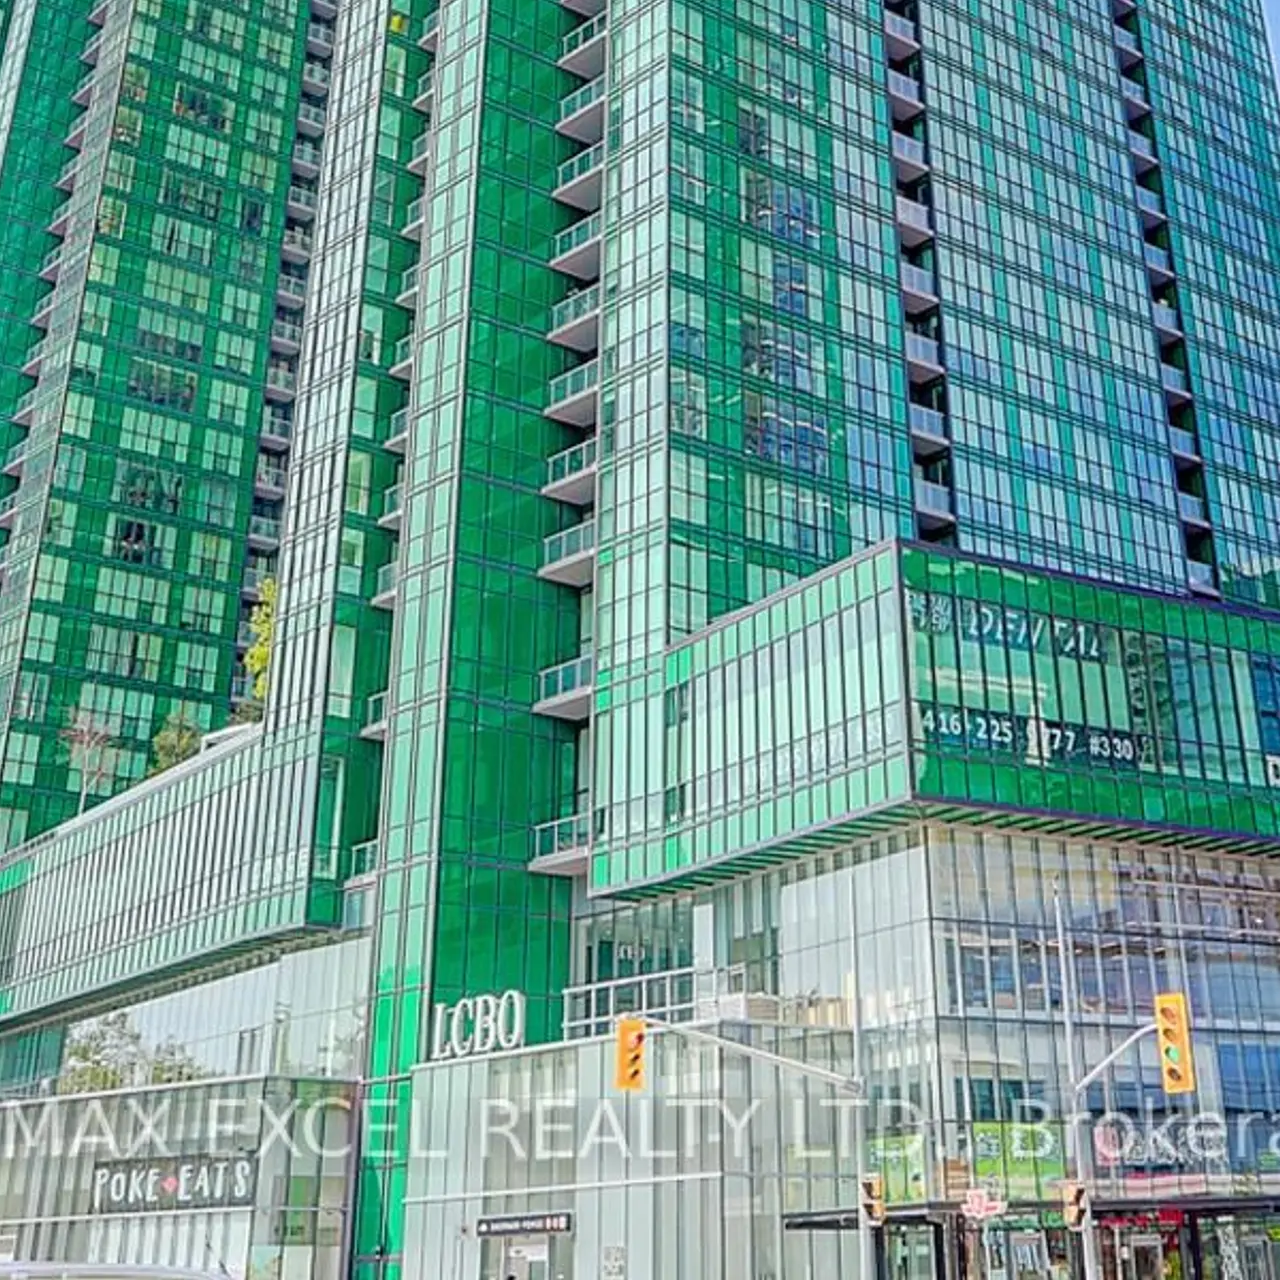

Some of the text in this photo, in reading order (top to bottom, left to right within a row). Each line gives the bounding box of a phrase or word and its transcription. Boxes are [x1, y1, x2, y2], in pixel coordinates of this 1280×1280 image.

[969, 606, 1101, 658] DENTAL
[1090, 736, 1134, 760] #330
[430, 990, 526, 1059] LCBO
[94, 1160, 250, 1209] POKE EATS
